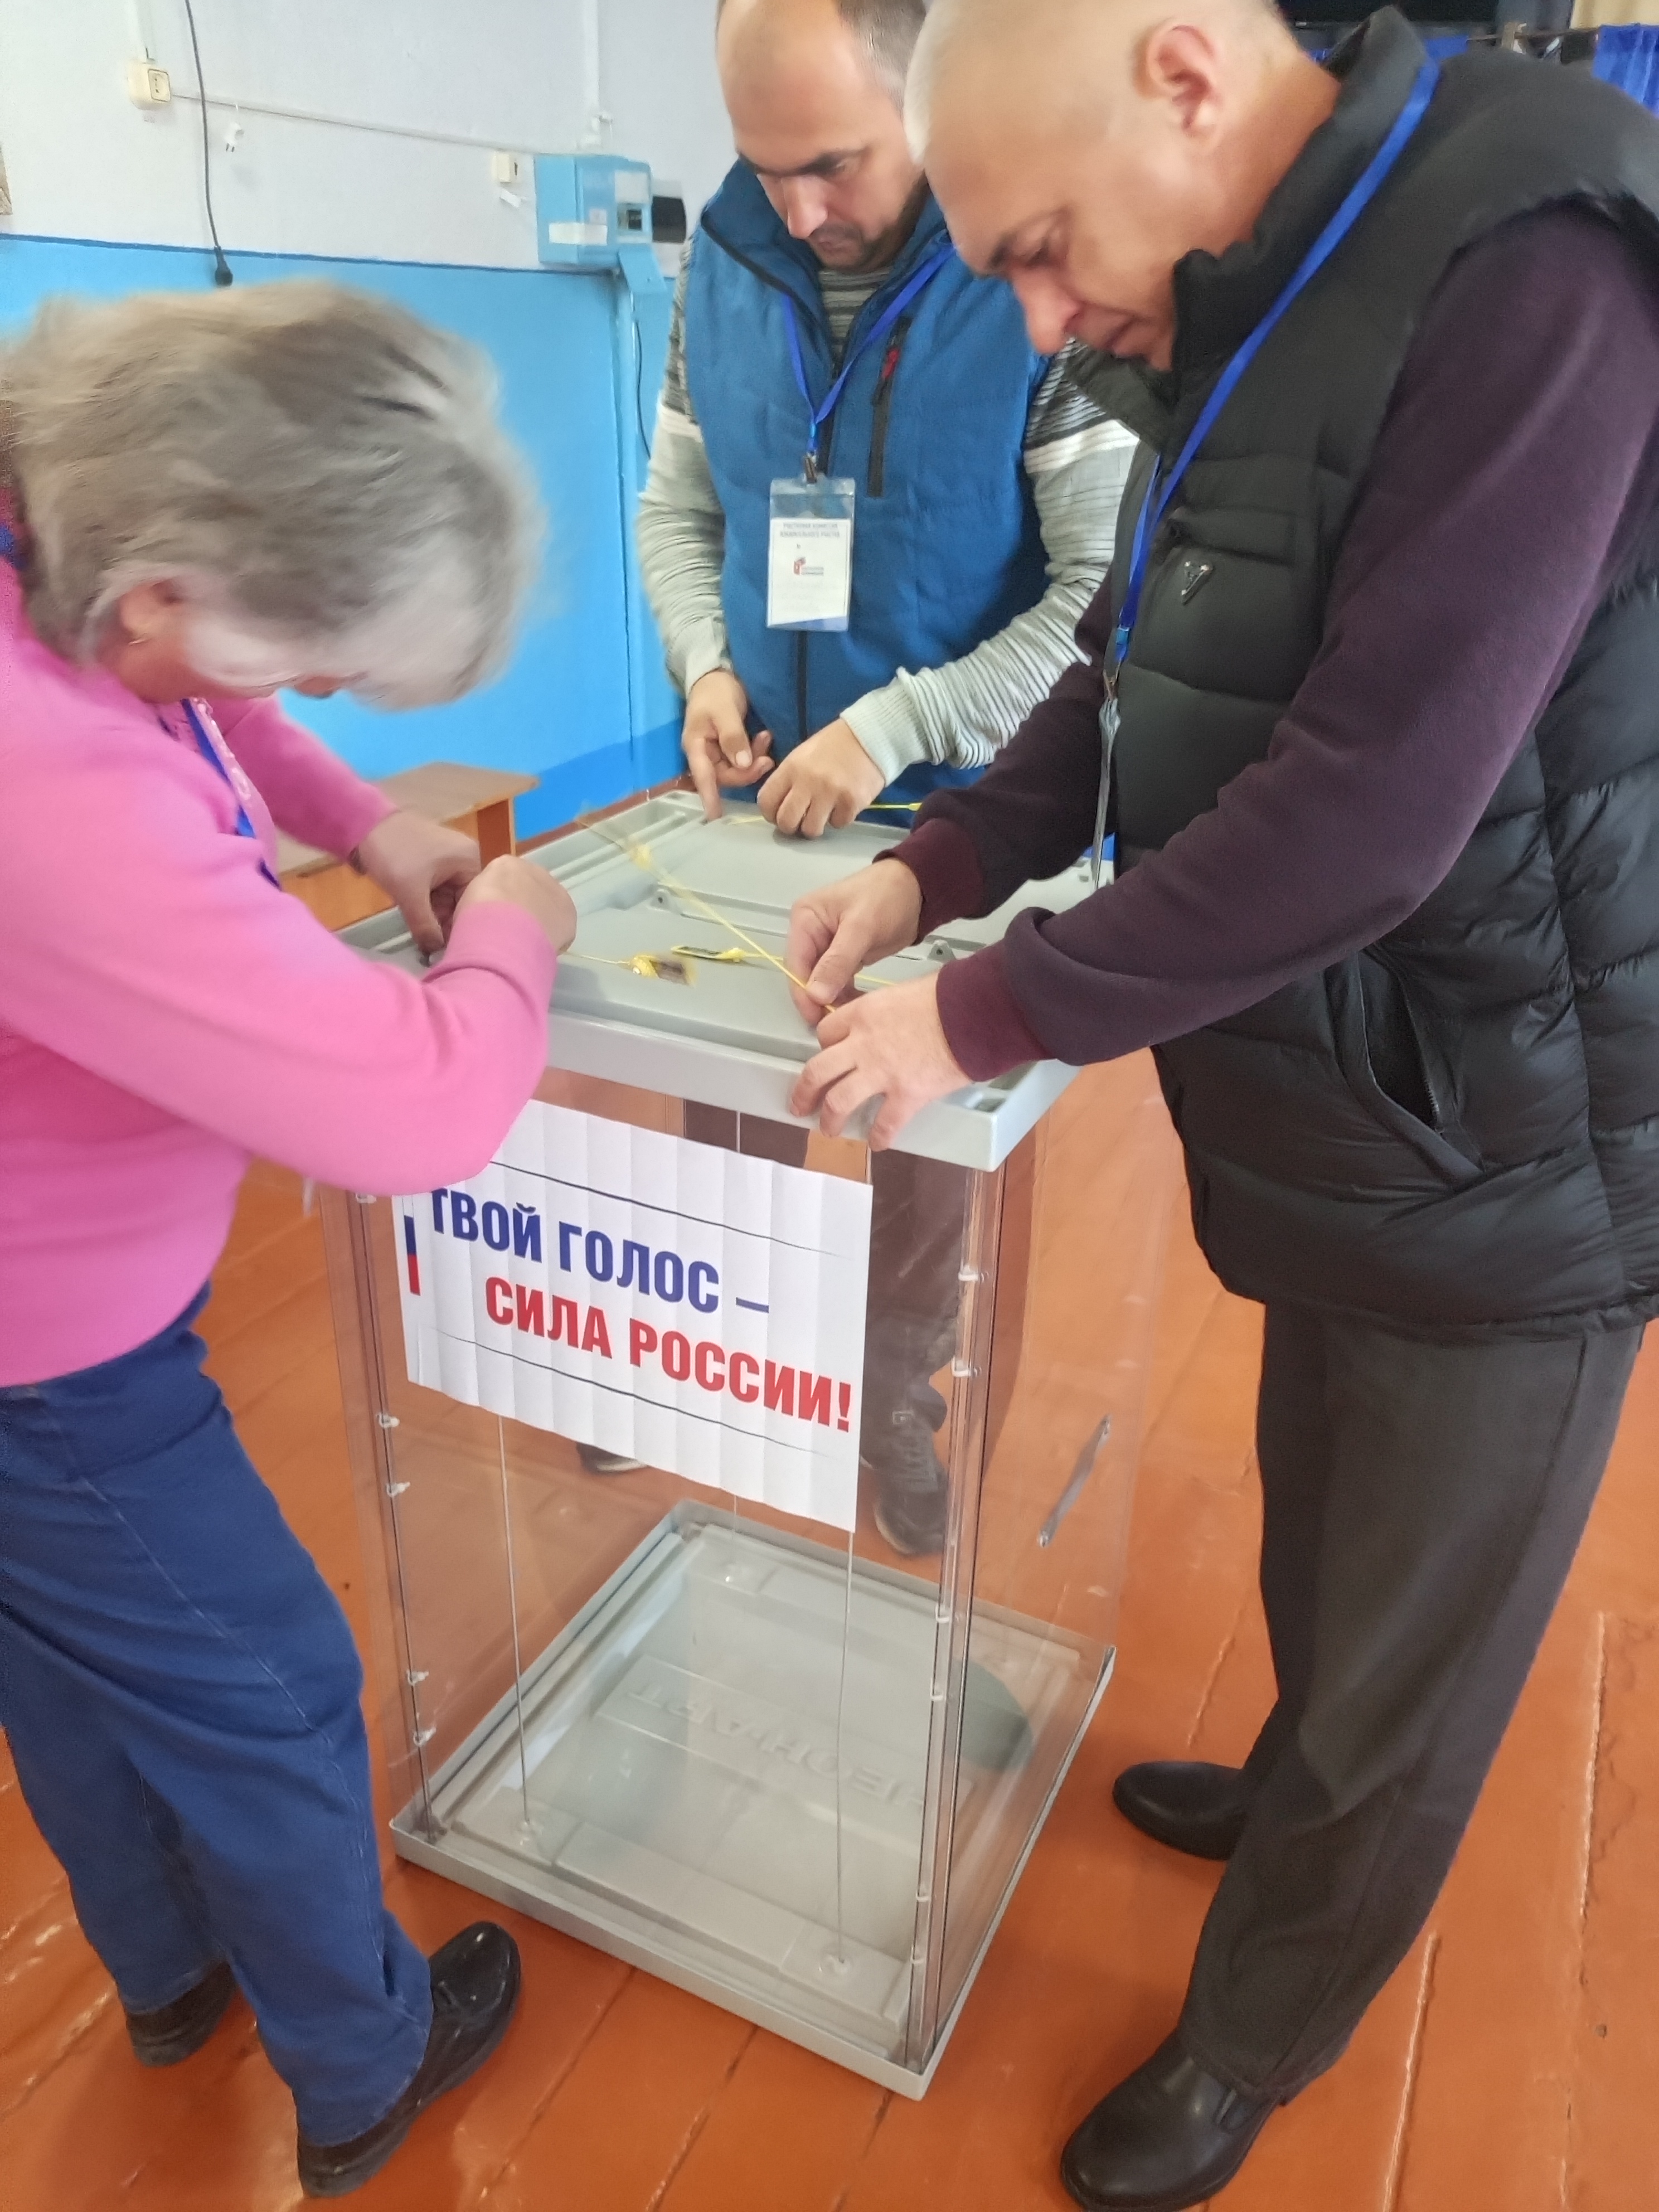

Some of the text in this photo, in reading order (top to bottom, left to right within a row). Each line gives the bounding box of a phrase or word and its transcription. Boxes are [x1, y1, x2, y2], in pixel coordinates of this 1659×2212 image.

[431, 1187, 542, 1264] ТВОЙ
[559, 1221, 720, 1314] ГОЛОС
[485, 1276, 852, 1433] СИЛА РОССИИ!
